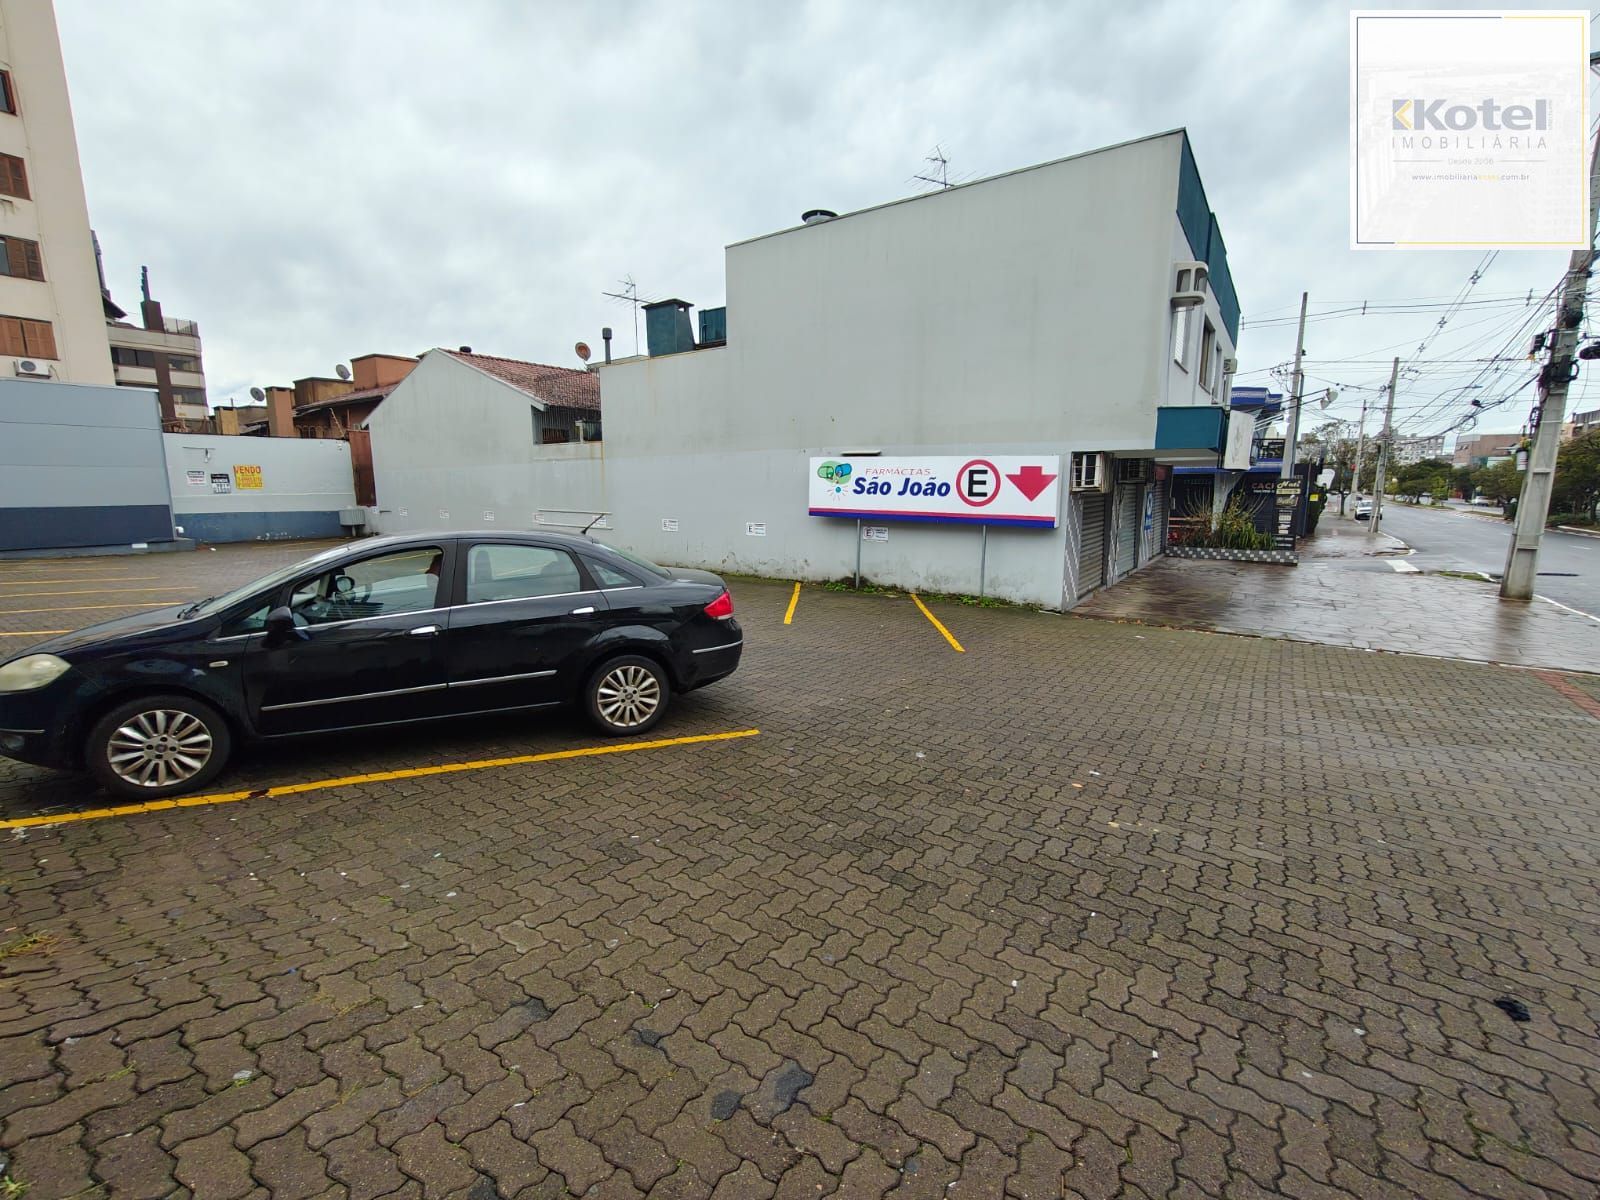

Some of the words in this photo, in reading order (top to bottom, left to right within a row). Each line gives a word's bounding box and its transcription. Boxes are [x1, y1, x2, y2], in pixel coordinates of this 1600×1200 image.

[233, 465, 262, 473] VENDO
[852, 477, 892, 495] São
[897, 477, 951, 497] João
[968, 469, 988, 497] E
[866, 528, 872, 537] E
